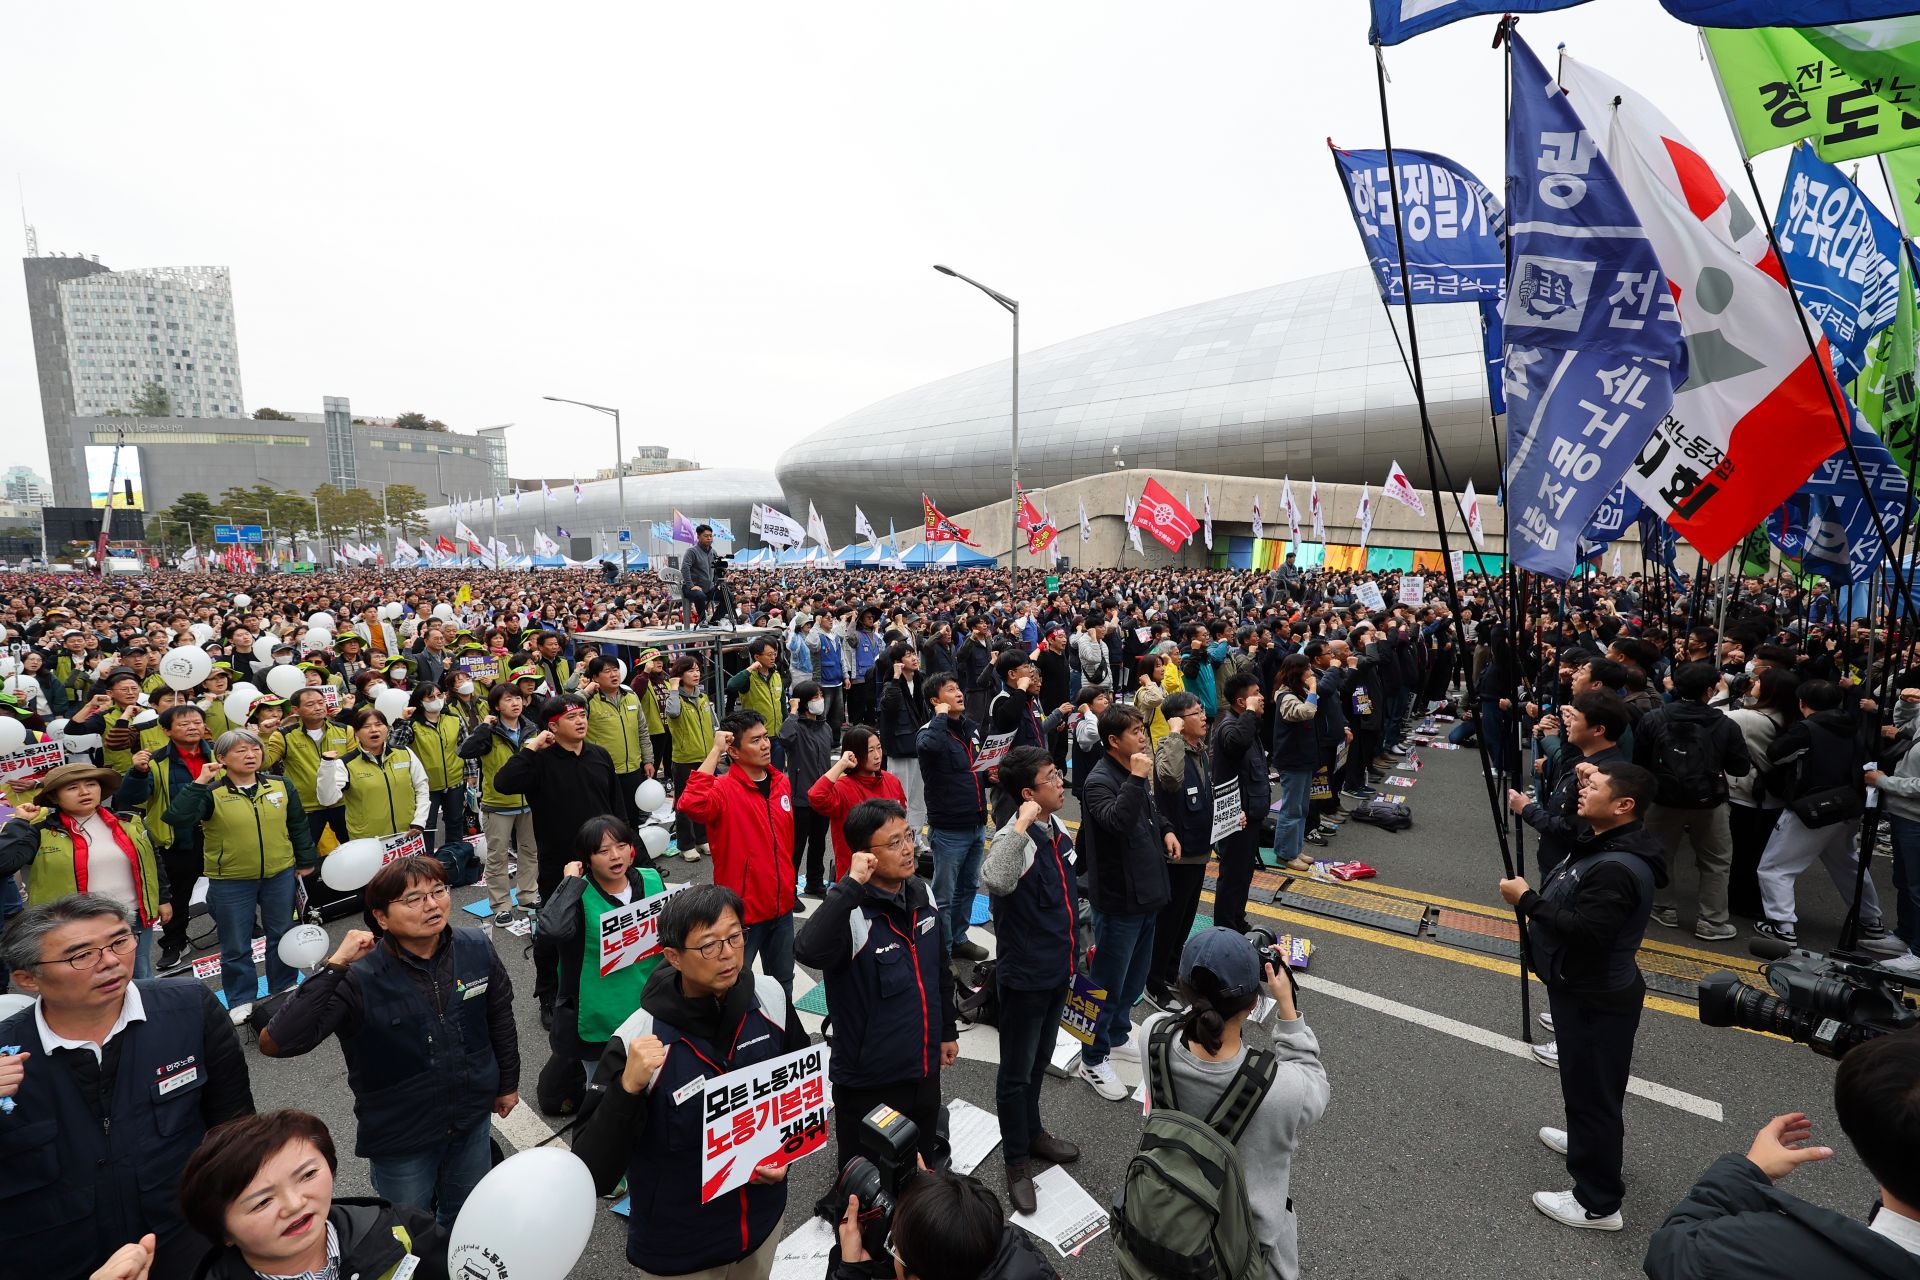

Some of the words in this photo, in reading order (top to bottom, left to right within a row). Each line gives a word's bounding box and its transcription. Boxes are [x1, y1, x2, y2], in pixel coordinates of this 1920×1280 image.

[1350, 163, 1505, 243] 한국정밀기
[12, 743, 59, 759] 노동자의
[602, 912, 634, 938] 모든
[636, 888, 686, 922] 노동
[603, 916, 660, 956] 노동기
[1061, 1005, 1095, 1037] 한다!
[706, 1083, 749, 1124] 모든
[753, 1050, 822, 1101] 노동자의
[706, 1075, 824, 1161] 노동기본권
[780, 1107, 826, 1154] 쟁취
